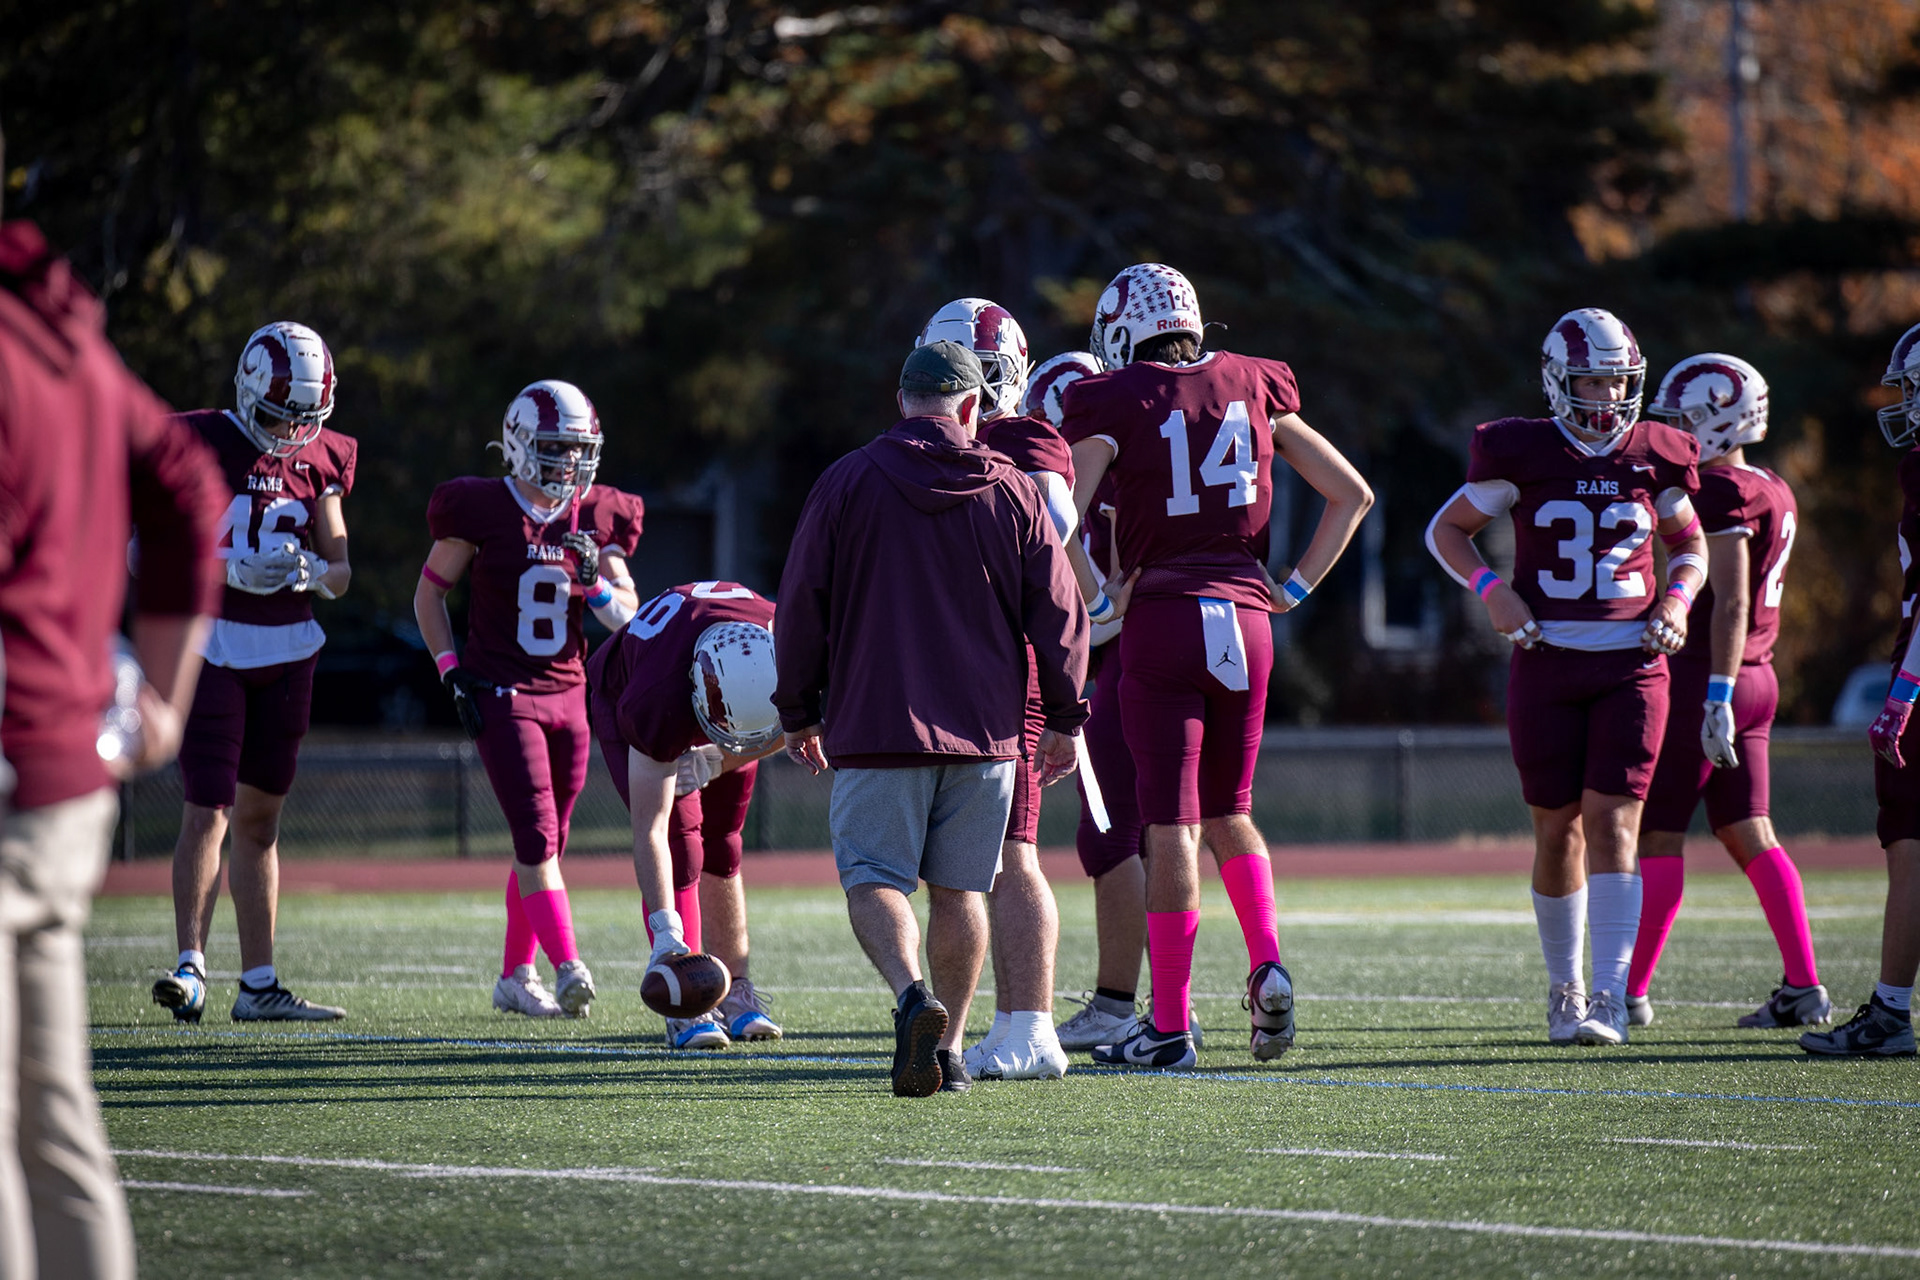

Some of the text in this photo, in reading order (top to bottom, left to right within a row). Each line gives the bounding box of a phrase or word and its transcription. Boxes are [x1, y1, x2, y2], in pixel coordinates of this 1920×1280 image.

[247, 474, 283, 492] RAMS
[1159, 400, 1259, 517] 14
[1575, 480, 1619, 495] RAMS
[526, 543, 565, 561] RAMS
[1534, 499, 1647, 600] 32
[516, 564, 572, 656] 8
